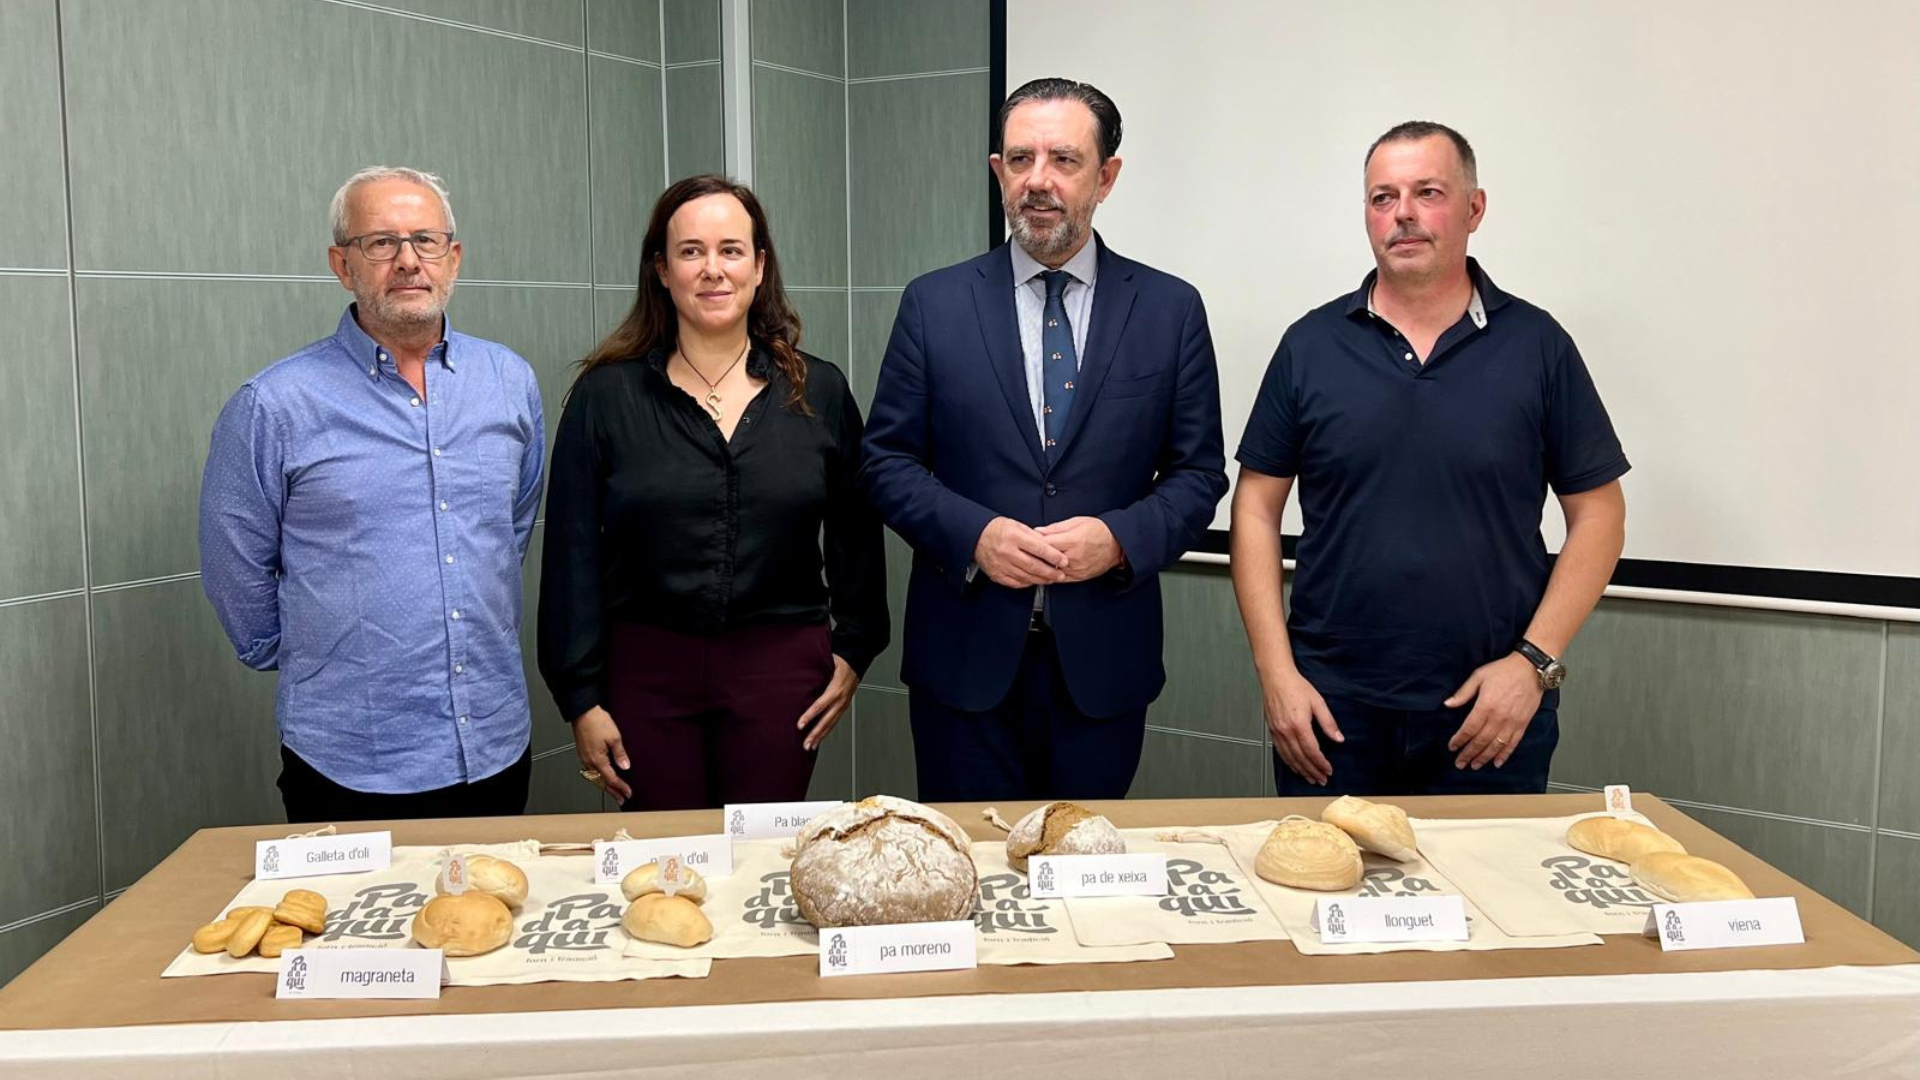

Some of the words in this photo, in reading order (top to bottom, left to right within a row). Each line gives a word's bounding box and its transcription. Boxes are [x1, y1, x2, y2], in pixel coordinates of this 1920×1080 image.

[774, 816, 788, 828] Pa
[791, 815, 811, 828] bla
[306, 850, 345, 863] Galleta
[349, 847, 370, 860] d'oli
[687, 852, 709, 865] d'oli
[1166, 859, 1235, 886] Pa
[1541, 855, 1630, 879] Pa
[1081, 873, 1097, 887] pa
[1100, 871, 1114, 884] de
[1118, 870, 1147, 883] xeixa
[1363, 867, 1441, 892] Pa
[355, 883, 428, 909] Pa
[547, 893, 623, 920] Pa
[1384, 913, 1434, 930] llonguet
[1727, 918, 1762, 932] viena
[831, 933, 847, 949] Pa
[880, 943, 897, 961] pa
[901, 942, 951, 957] moreno
[292, 955, 307, 971] Pa
[340, 967, 415, 987] magraneta
